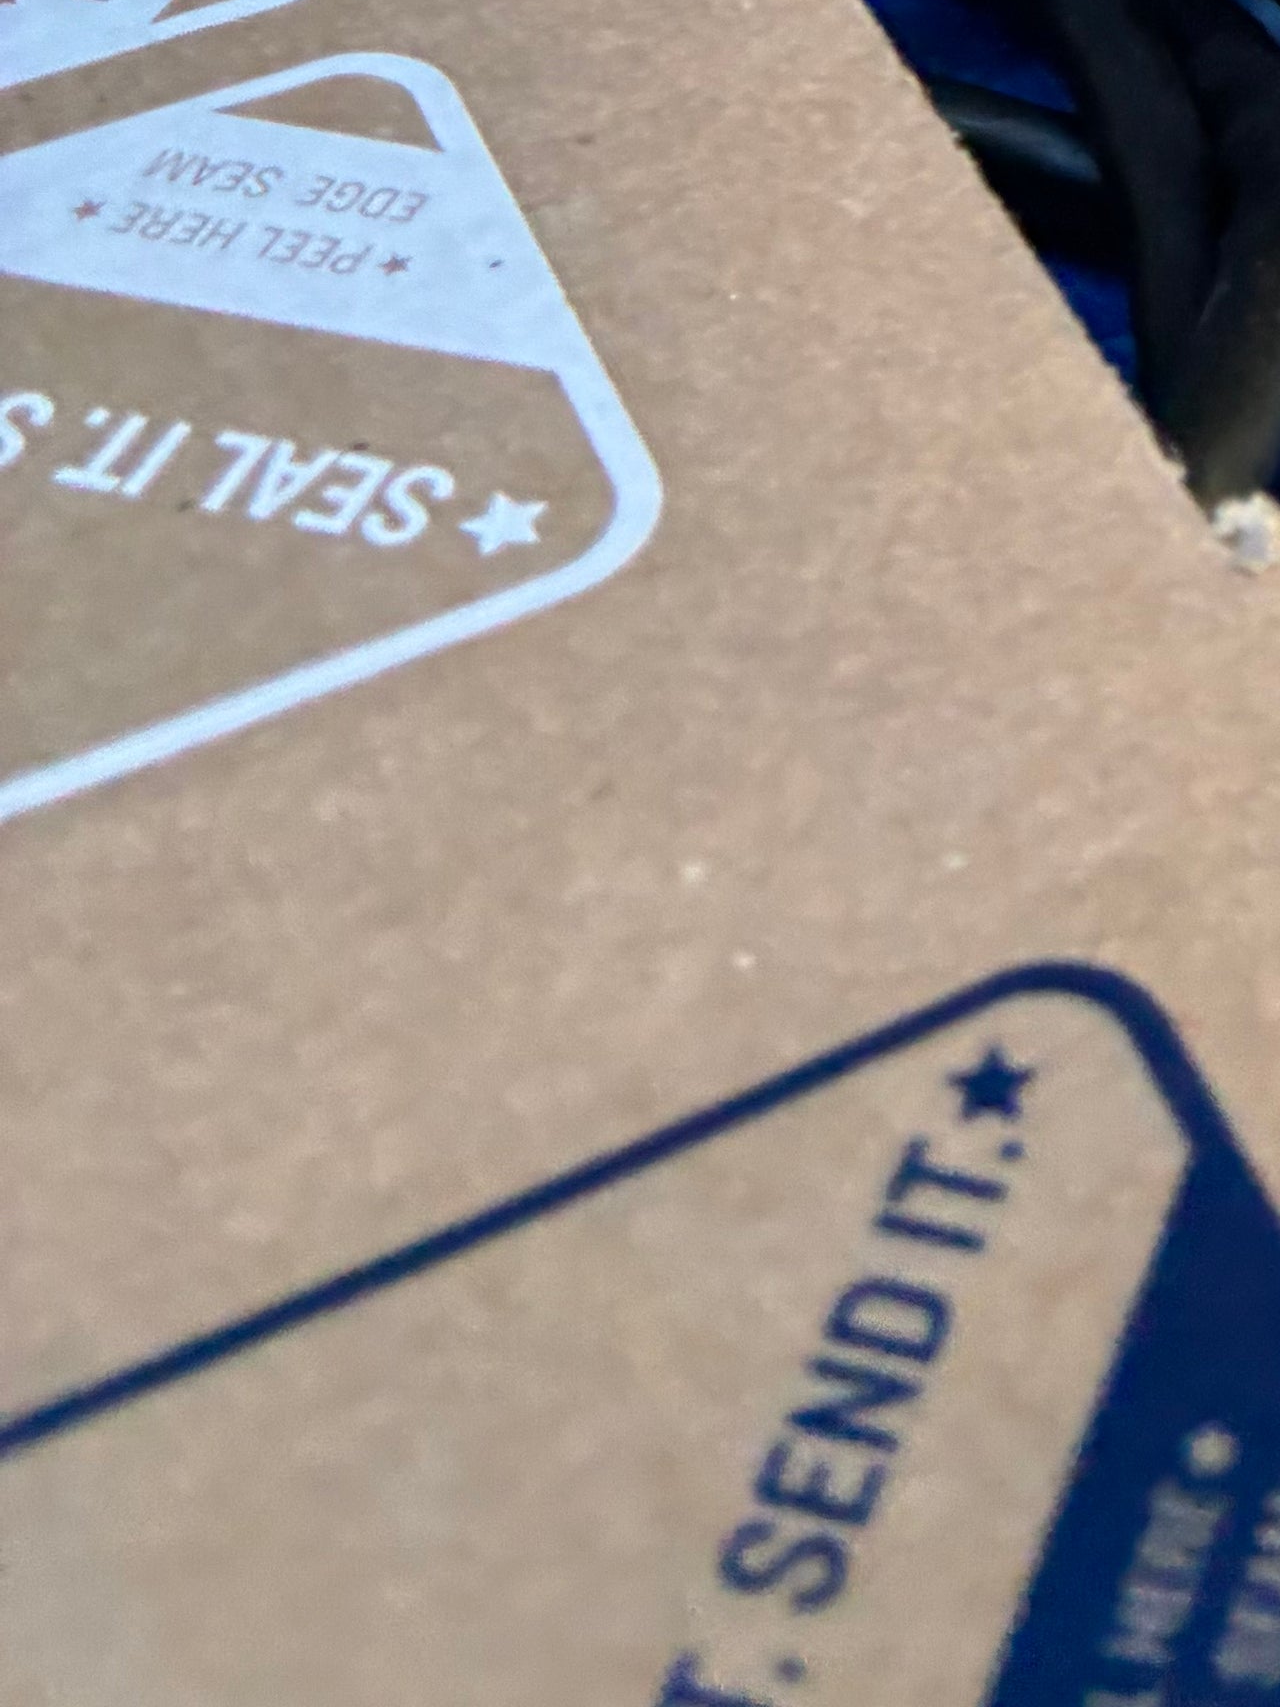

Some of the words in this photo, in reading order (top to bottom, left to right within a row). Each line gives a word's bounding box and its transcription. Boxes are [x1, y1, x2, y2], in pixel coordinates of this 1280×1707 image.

[142, 147, 285, 199] SEAM
[295, 174, 429, 223] EDGE
[107, 201, 248, 251] HERE
[254, 224, 374, 275] PEEL
[52, 407, 193, 501] IT.
[200, 427, 456, 547] SEAL
[716, 1275, 956, 1615] SEND
[874, 1134, 1026, 1253] IT.
